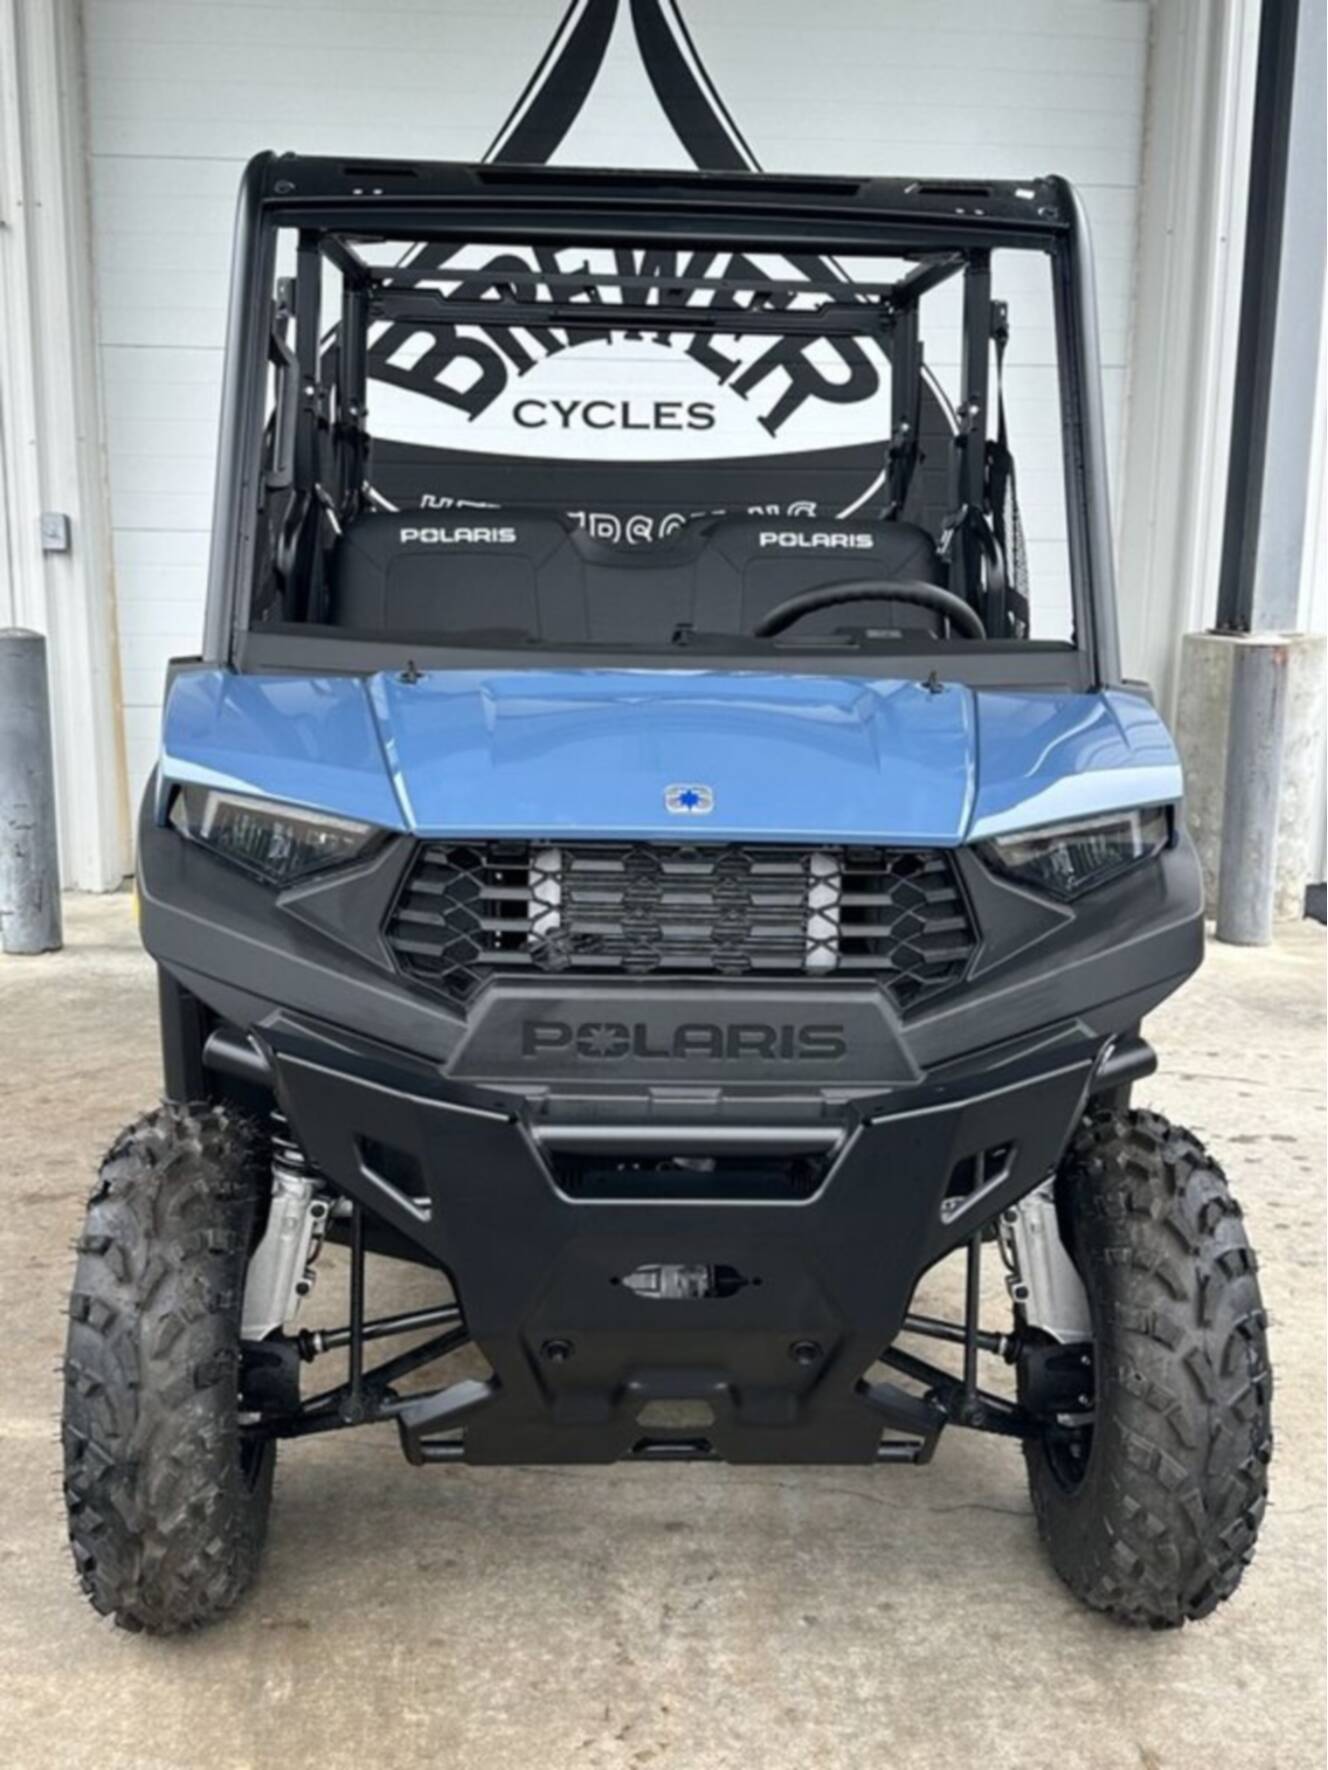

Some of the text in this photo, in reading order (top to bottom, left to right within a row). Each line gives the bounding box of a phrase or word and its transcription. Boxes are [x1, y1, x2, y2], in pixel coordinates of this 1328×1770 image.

[512, 399, 717, 431] CYCLES
[400, 526, 517, 545] POLARIS
[759, 531, 875, 549] POLARIS
[521, 1021, 847, 1060] POLARIS
